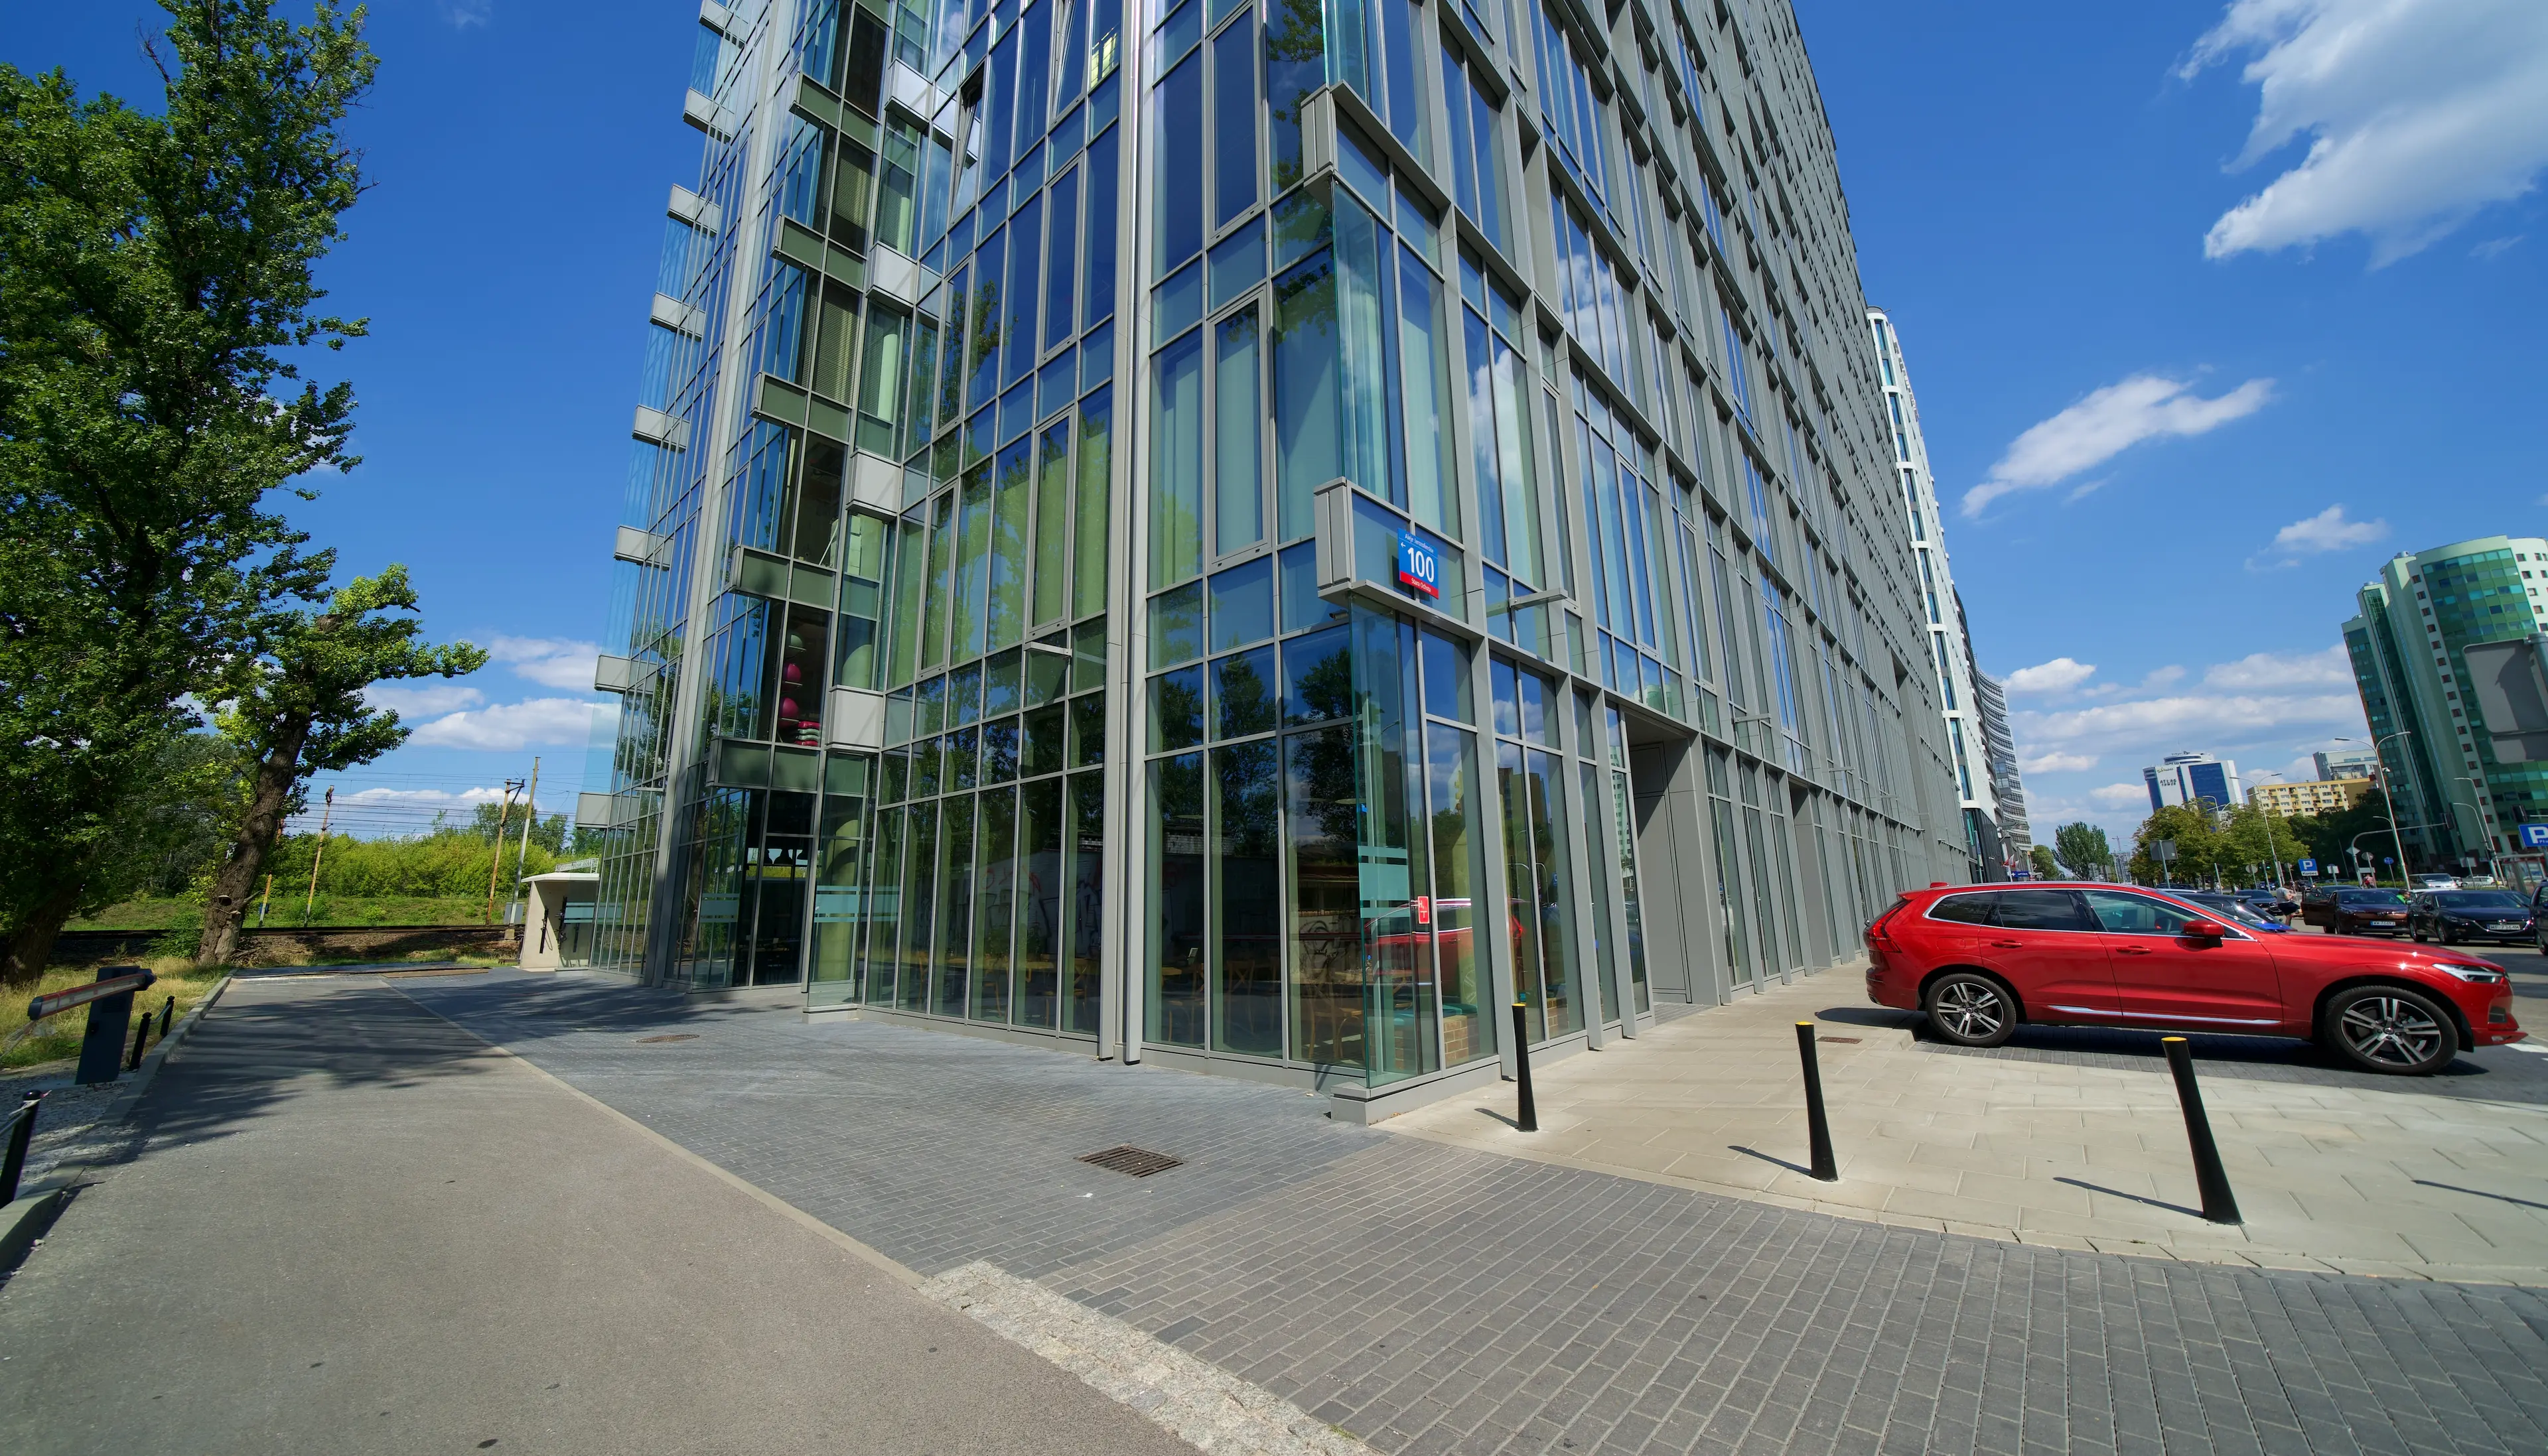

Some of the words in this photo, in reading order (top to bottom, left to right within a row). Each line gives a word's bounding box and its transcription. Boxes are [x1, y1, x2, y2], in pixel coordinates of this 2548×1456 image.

[1407, 547, 1435, 582] 100
[1411, 578, 1420, 586] Stara
[1420, 582, 1431, 592] Ochota
[2528, 827, 2548, 844] P
[2302, 860, 2313, 870] P
